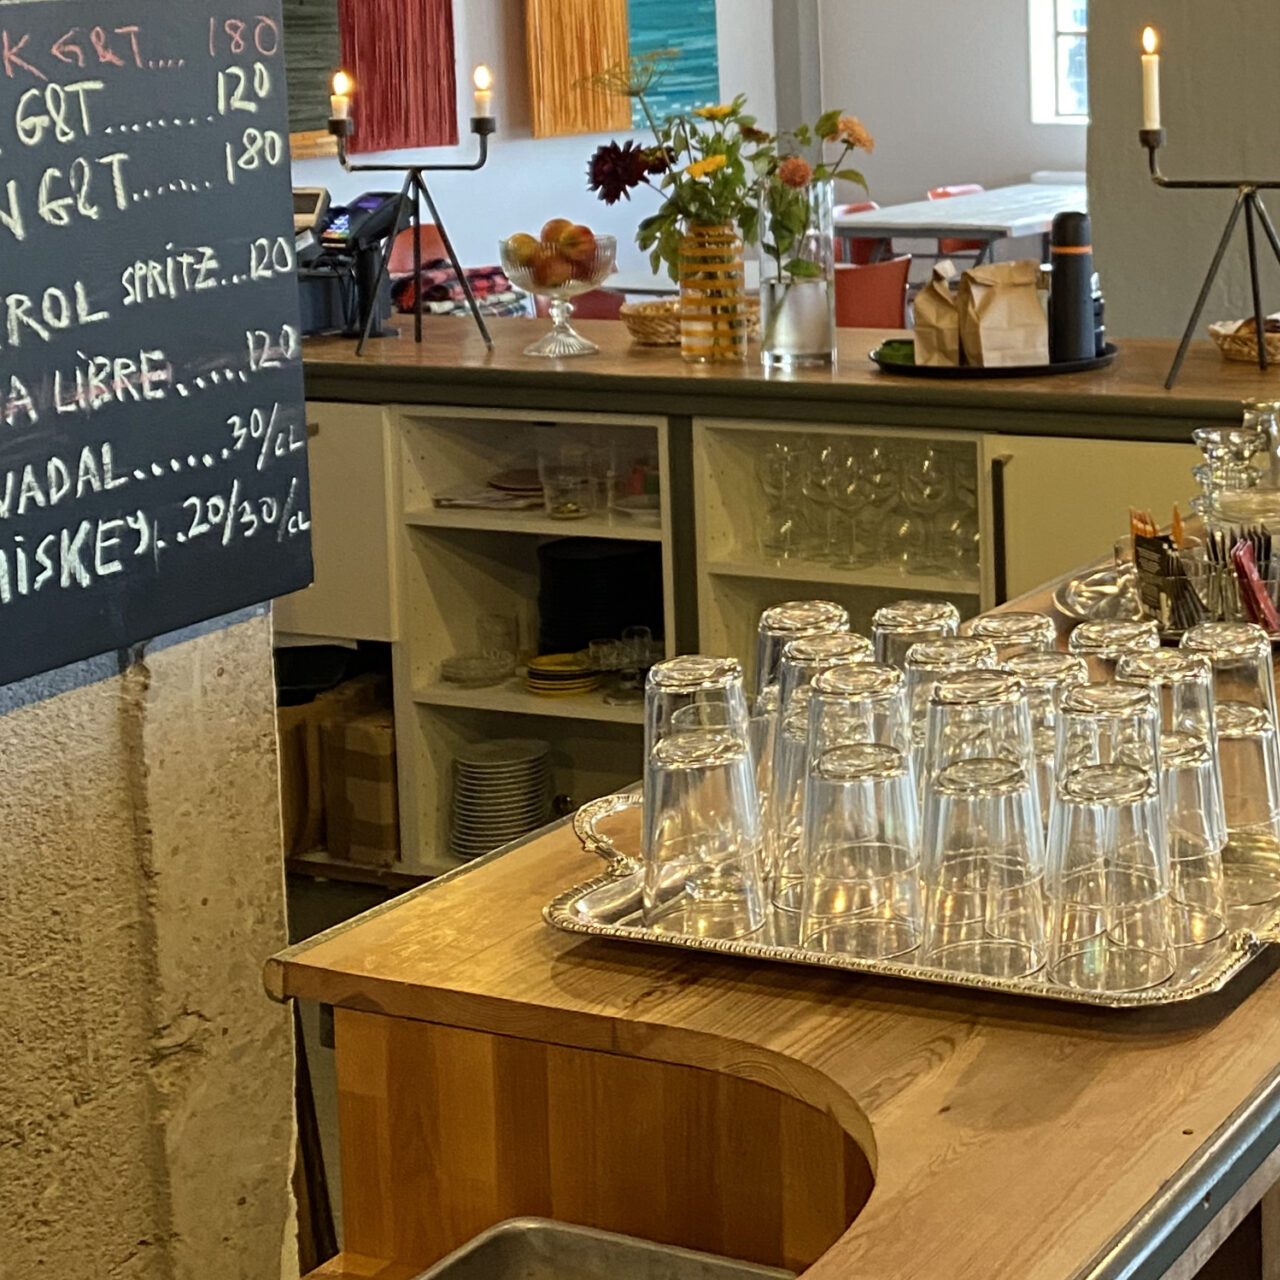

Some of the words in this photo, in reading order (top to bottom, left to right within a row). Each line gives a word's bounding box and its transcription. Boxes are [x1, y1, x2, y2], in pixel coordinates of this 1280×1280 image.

[209, 15, 279, 57] 180
[15, 80, 105, 146] G&T
[217, 61, 271, 116] 120
[38, 152, 129, 226] G&T
[225, 127, 283, 184] 180
[5, 280, 110, 347] ROL
[250, 236, 293, 281] 120
[246, 324, 298, 372] 120
